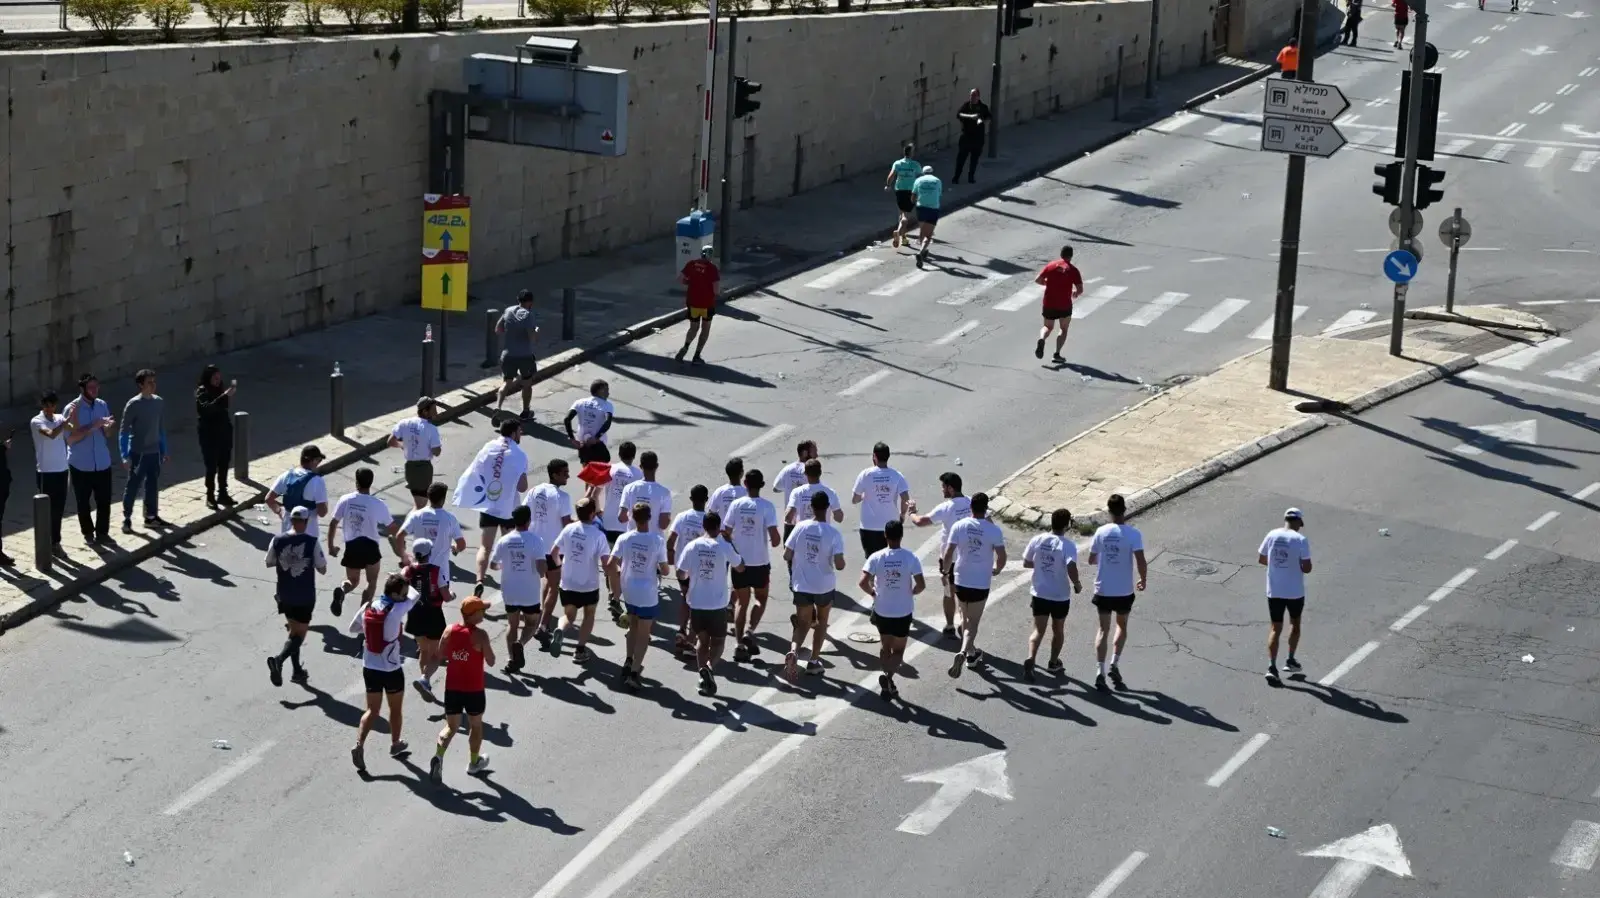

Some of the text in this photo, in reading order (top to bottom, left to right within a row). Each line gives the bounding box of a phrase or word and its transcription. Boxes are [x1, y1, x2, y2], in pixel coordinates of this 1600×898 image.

[1294, 84, 1328, 97] ממילא
[1292, 105, 1326, 116] Mamila
[1294, 124, 1324, 136] קרתא
[1295, 142, 1319, 152] Karta
